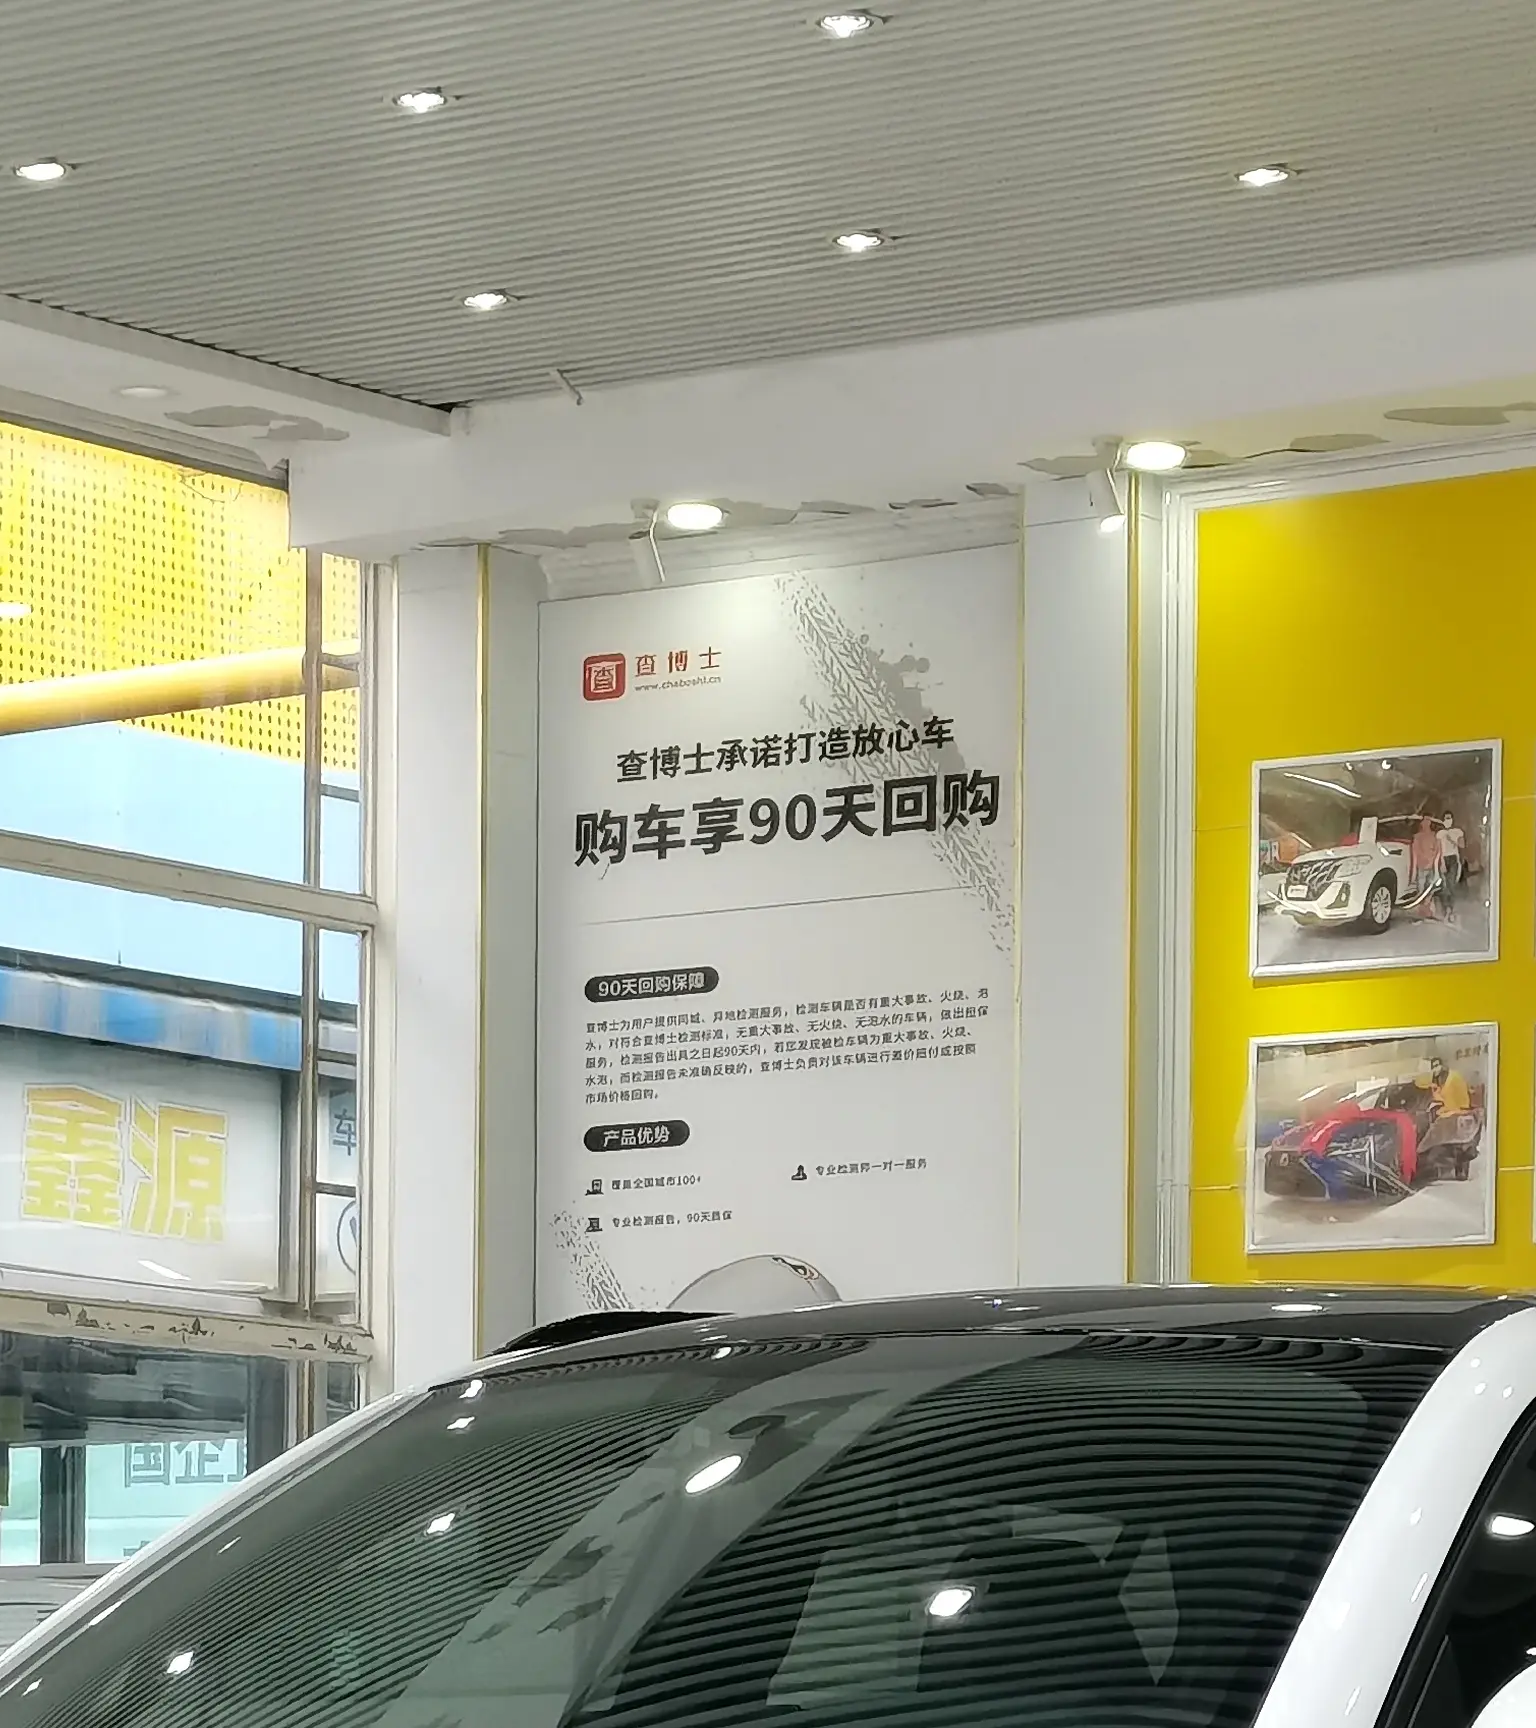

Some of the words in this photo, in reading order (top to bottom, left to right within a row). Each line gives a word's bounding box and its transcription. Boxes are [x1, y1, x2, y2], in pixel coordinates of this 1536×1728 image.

[634, 646, 722, 678] 查博士
[616, 715, 955, 784] 查博士承诺打造放心车
[573, 769, 1001, 868] 购车享90天回购
[597, 971, 705, 998] 90天回购保障
[602, 1123, 671, 1149] 产品优势
